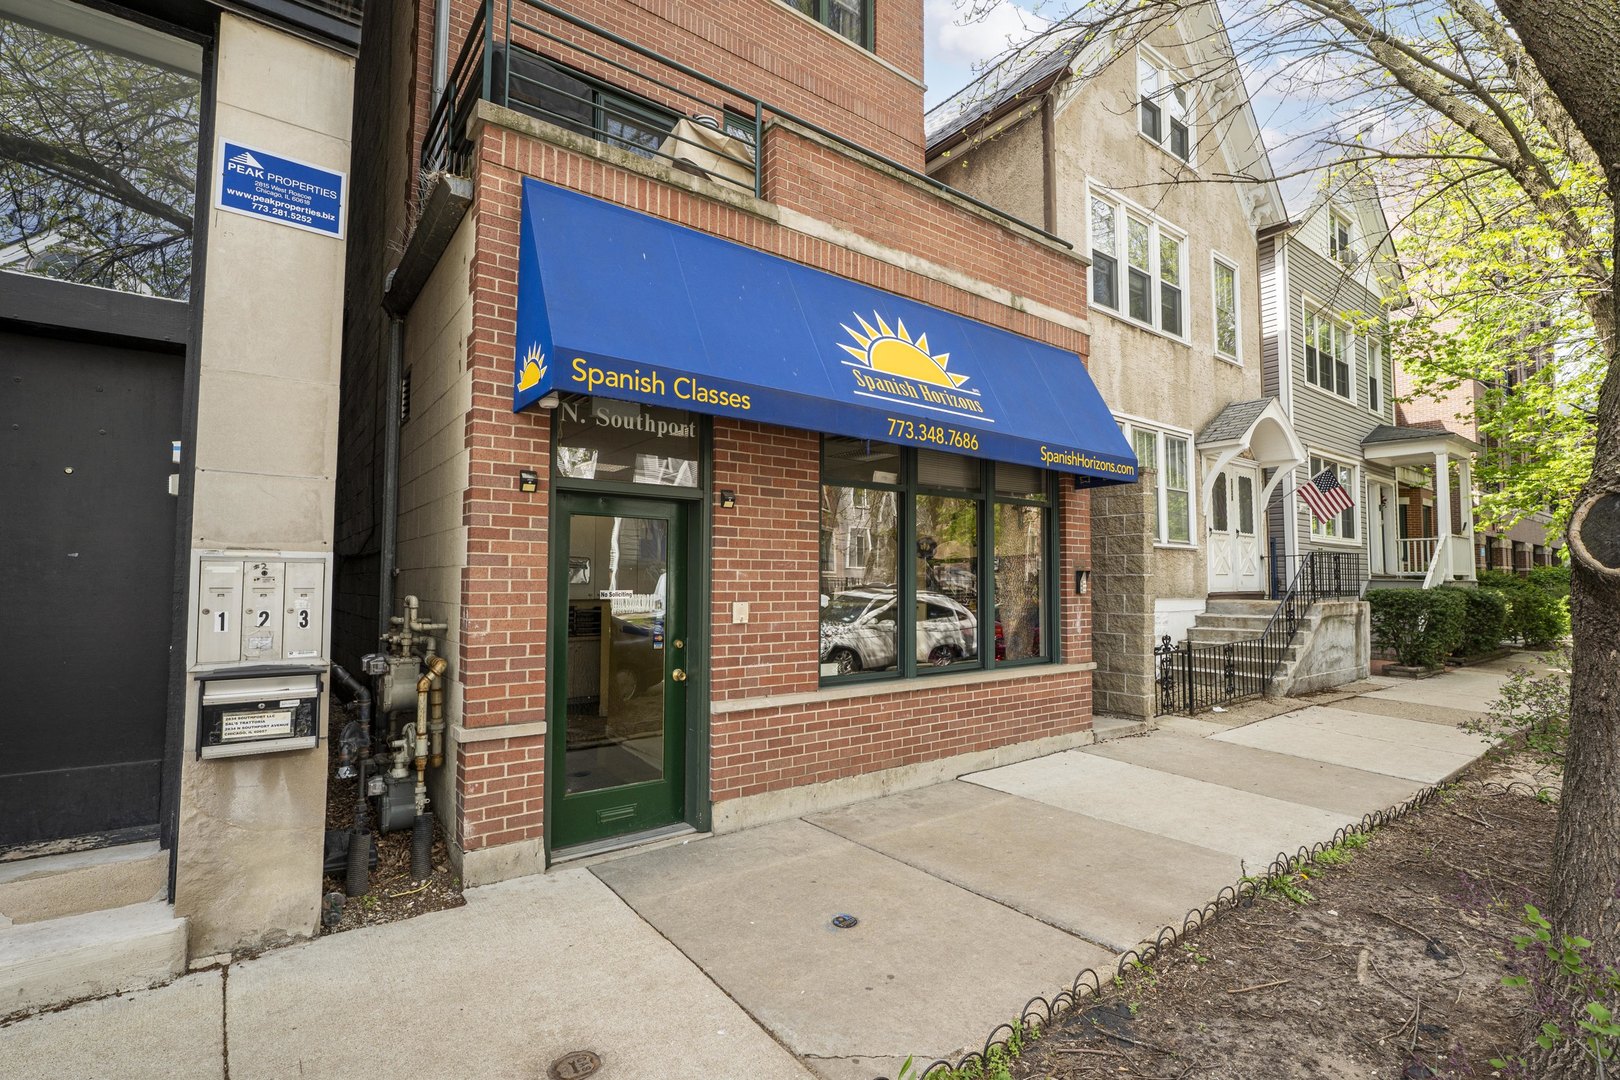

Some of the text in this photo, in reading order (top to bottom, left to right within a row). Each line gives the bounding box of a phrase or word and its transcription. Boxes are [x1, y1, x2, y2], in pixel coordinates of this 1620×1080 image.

[227, 162, 338, 200] PEAK PROPERTIES
[271, 184, 287, 194] West
[288, 189, 312, 201] Roscoe
[226, 187, 336, 222] www.peakproperties.biz
[251, 202, 312, 224] 773.281.5252
[571, 357, 751, 411] Spanish Classes
[852, 368, 985, 414] Spanish Horizons
[560, 402, 696, 439] N. Southport
[887, 417, 979, 451] 773.348.7686
[1040, 445, 1135, 476] SpanishHorizons.com
[608, 591, 632, 599] Soliciting
[218, 611, 225, 632] 1
[257, 610, 270, 628] 2
[299, 610, 309, 628] 3
